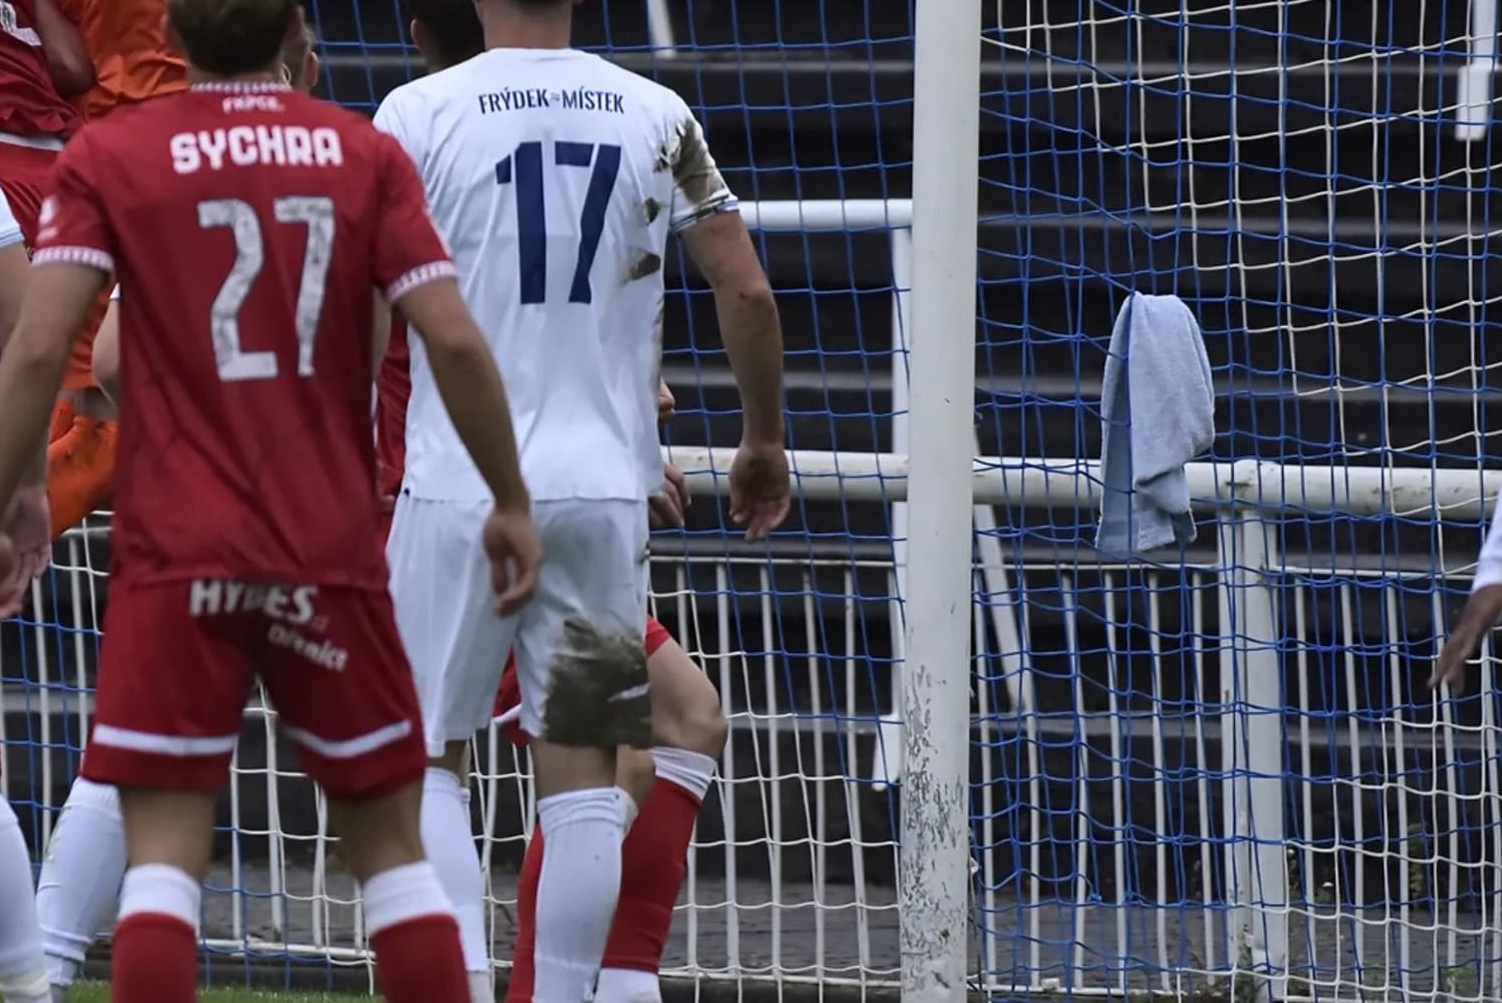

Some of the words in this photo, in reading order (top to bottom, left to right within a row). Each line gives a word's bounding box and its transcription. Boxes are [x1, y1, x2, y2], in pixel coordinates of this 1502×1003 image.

[170, 124, 344, 175] SYCHRA
[495, 139, 622, 305] 17
[198, 196, 335, 382] 27
